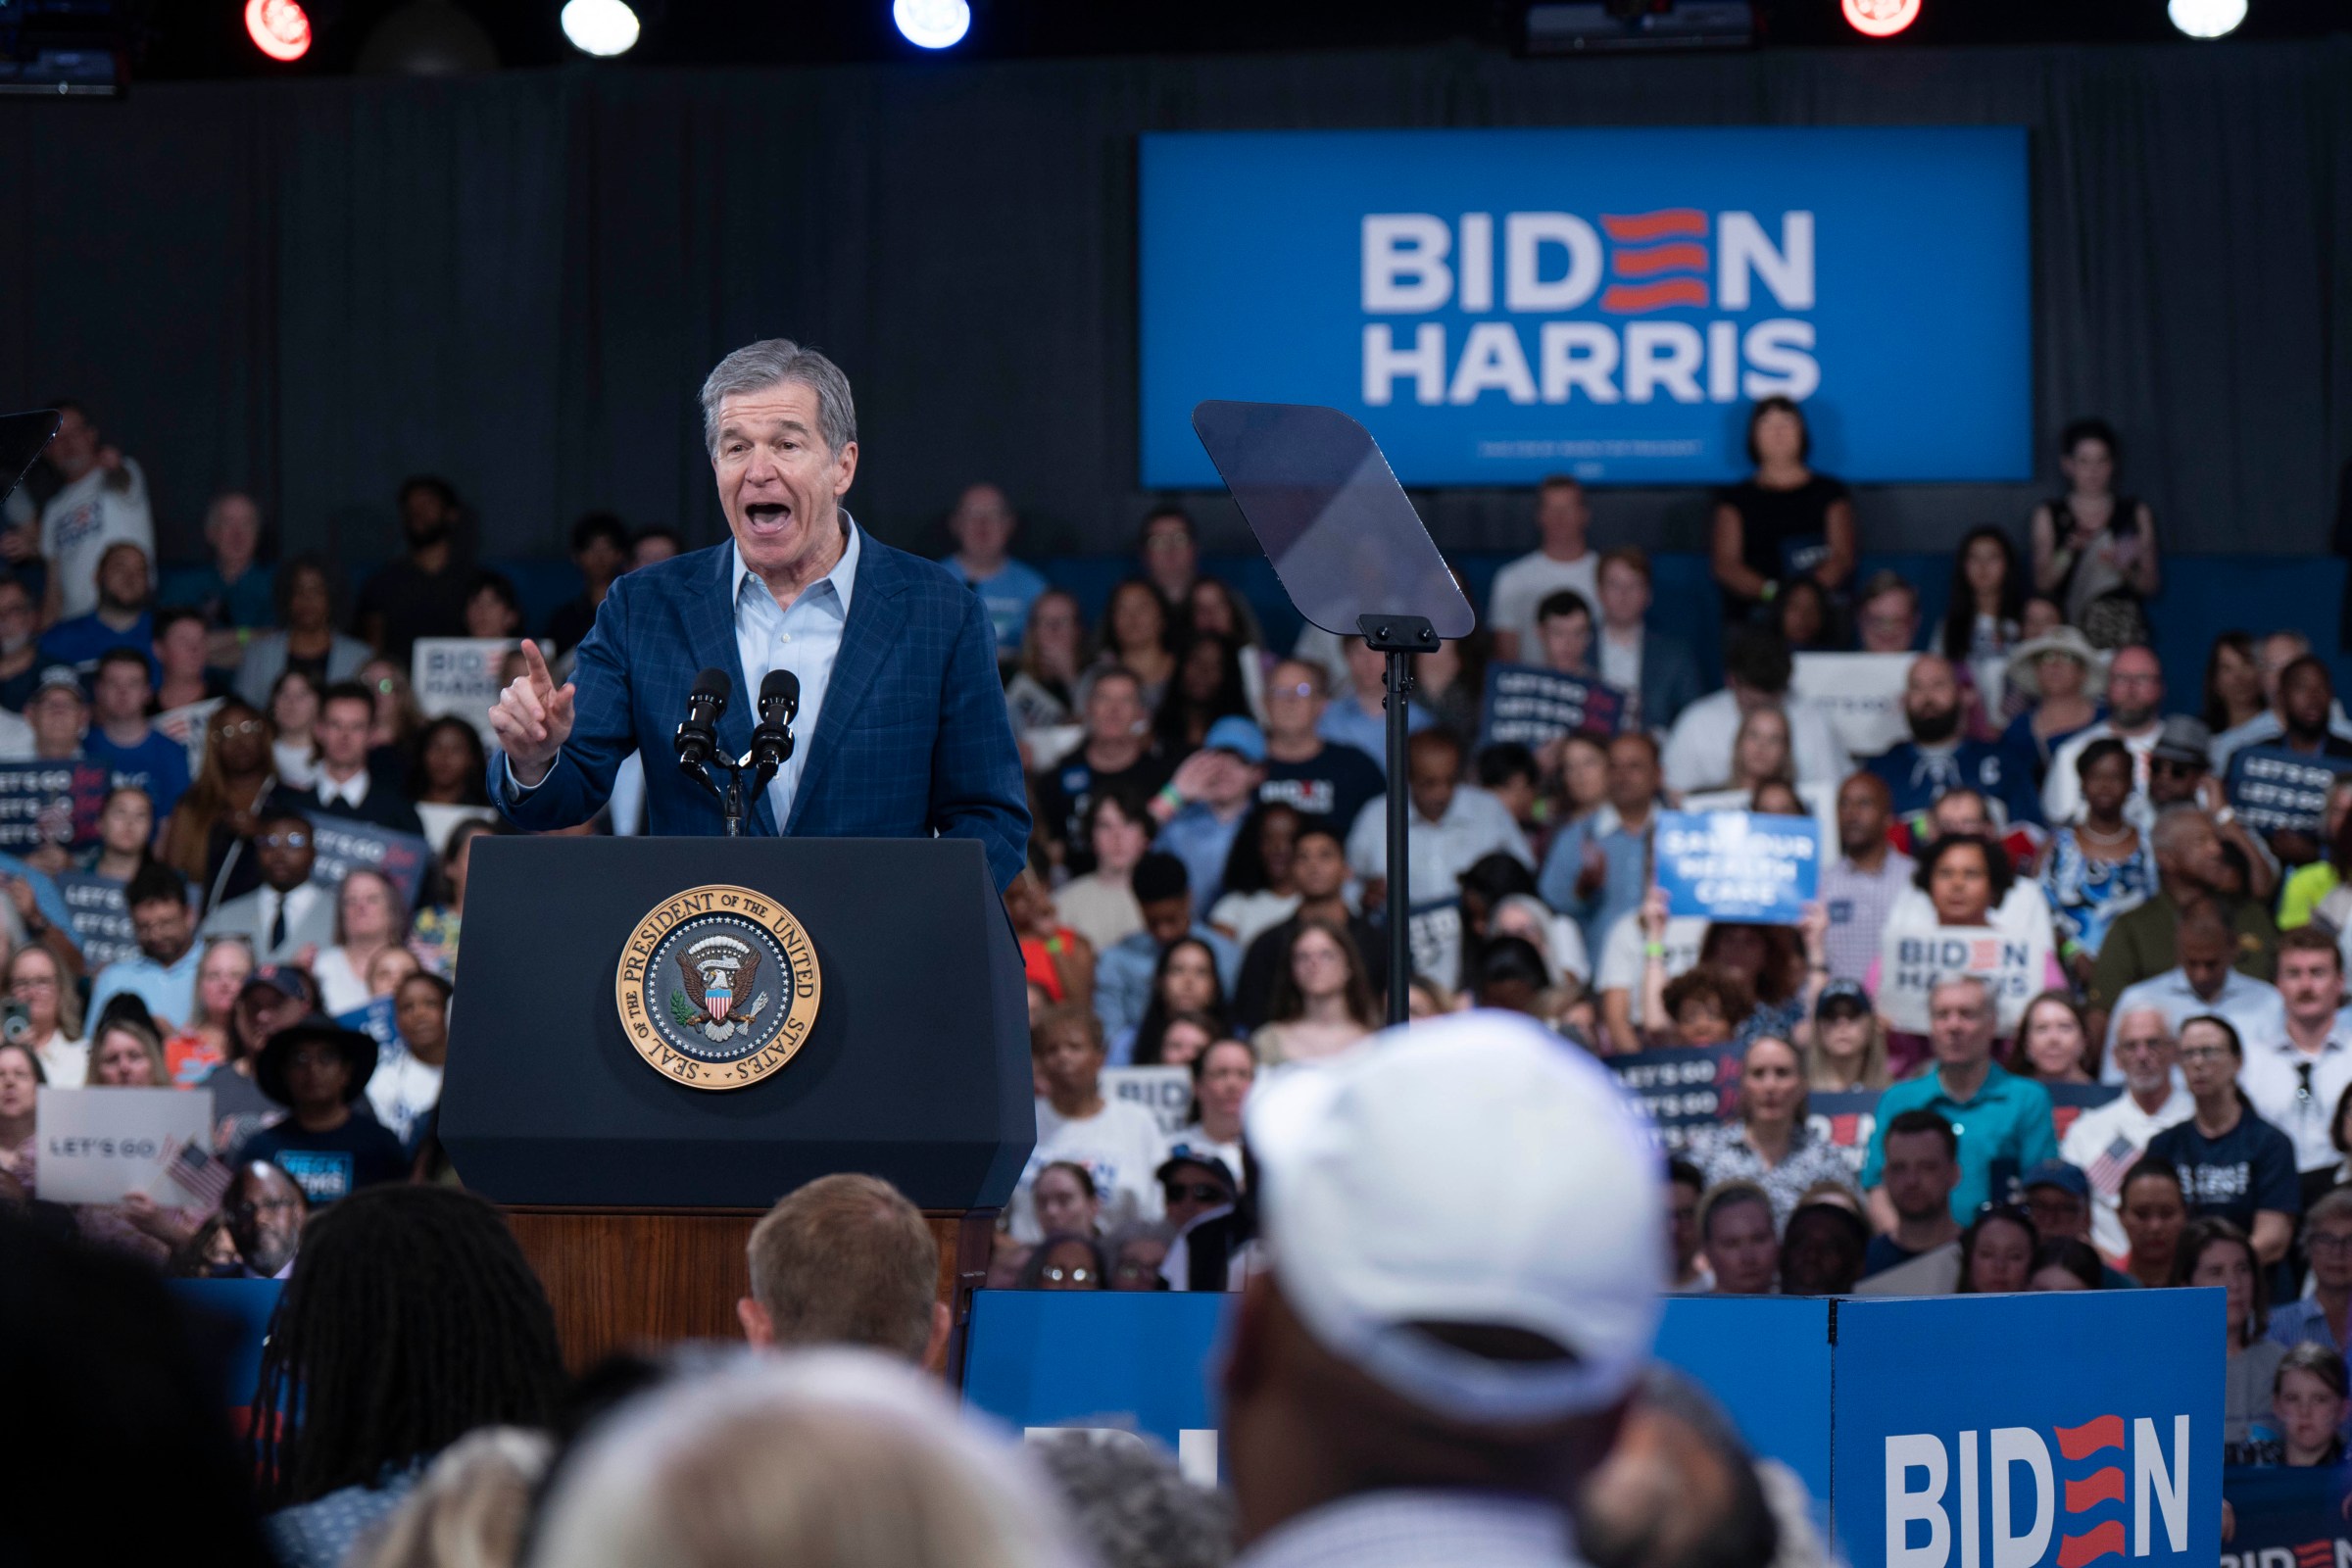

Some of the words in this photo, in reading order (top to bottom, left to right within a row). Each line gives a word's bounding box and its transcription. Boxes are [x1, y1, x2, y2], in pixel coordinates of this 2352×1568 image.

[1359, 208, 1817, 314] BIDEN
[1360, 318, 1822, 406] HARRIS
[0, 770, 40, 793] ET'S
[40, 769, 72, 792] GO
[2243, 756, 2302, 784] LET'S
[2302, 765, 2335, 789] GO
[0, 798, 40, 818] ET'S
[2237, 780, 2295, 808] LET'S
[2295, 790, 2327, 811] GO
[66, 884, 124, 910] LET'S
[720, 894, 740, 907] OF
[1693, 879, 1777, 906] CARE
[743, 899, 769, 918] THE
[73, 911, 119, 936] ET'S
[623, 892, 714, 983] PRESIDENT
[772, 915, 815, 999] UNITED
[1897, 938, 2030, 969] BIDEN
[625, 991, 641, 1019] THE
[632, 1021, 649, 1040] OF
[648, 1036, 701, 1080] SEAL
[735, 1017, 806, 1080] STATES
[1680, 1059, 1717, 1085] GO
[1116, 1080, 1193, 1109] BID
[1682, 1090, 1719, 1115] GO
[49, 1137, 117, 1158] LET'S
[119, 1137, 157, 1160] GO
[1885, 1414, 2190, 1568] BIDEN
